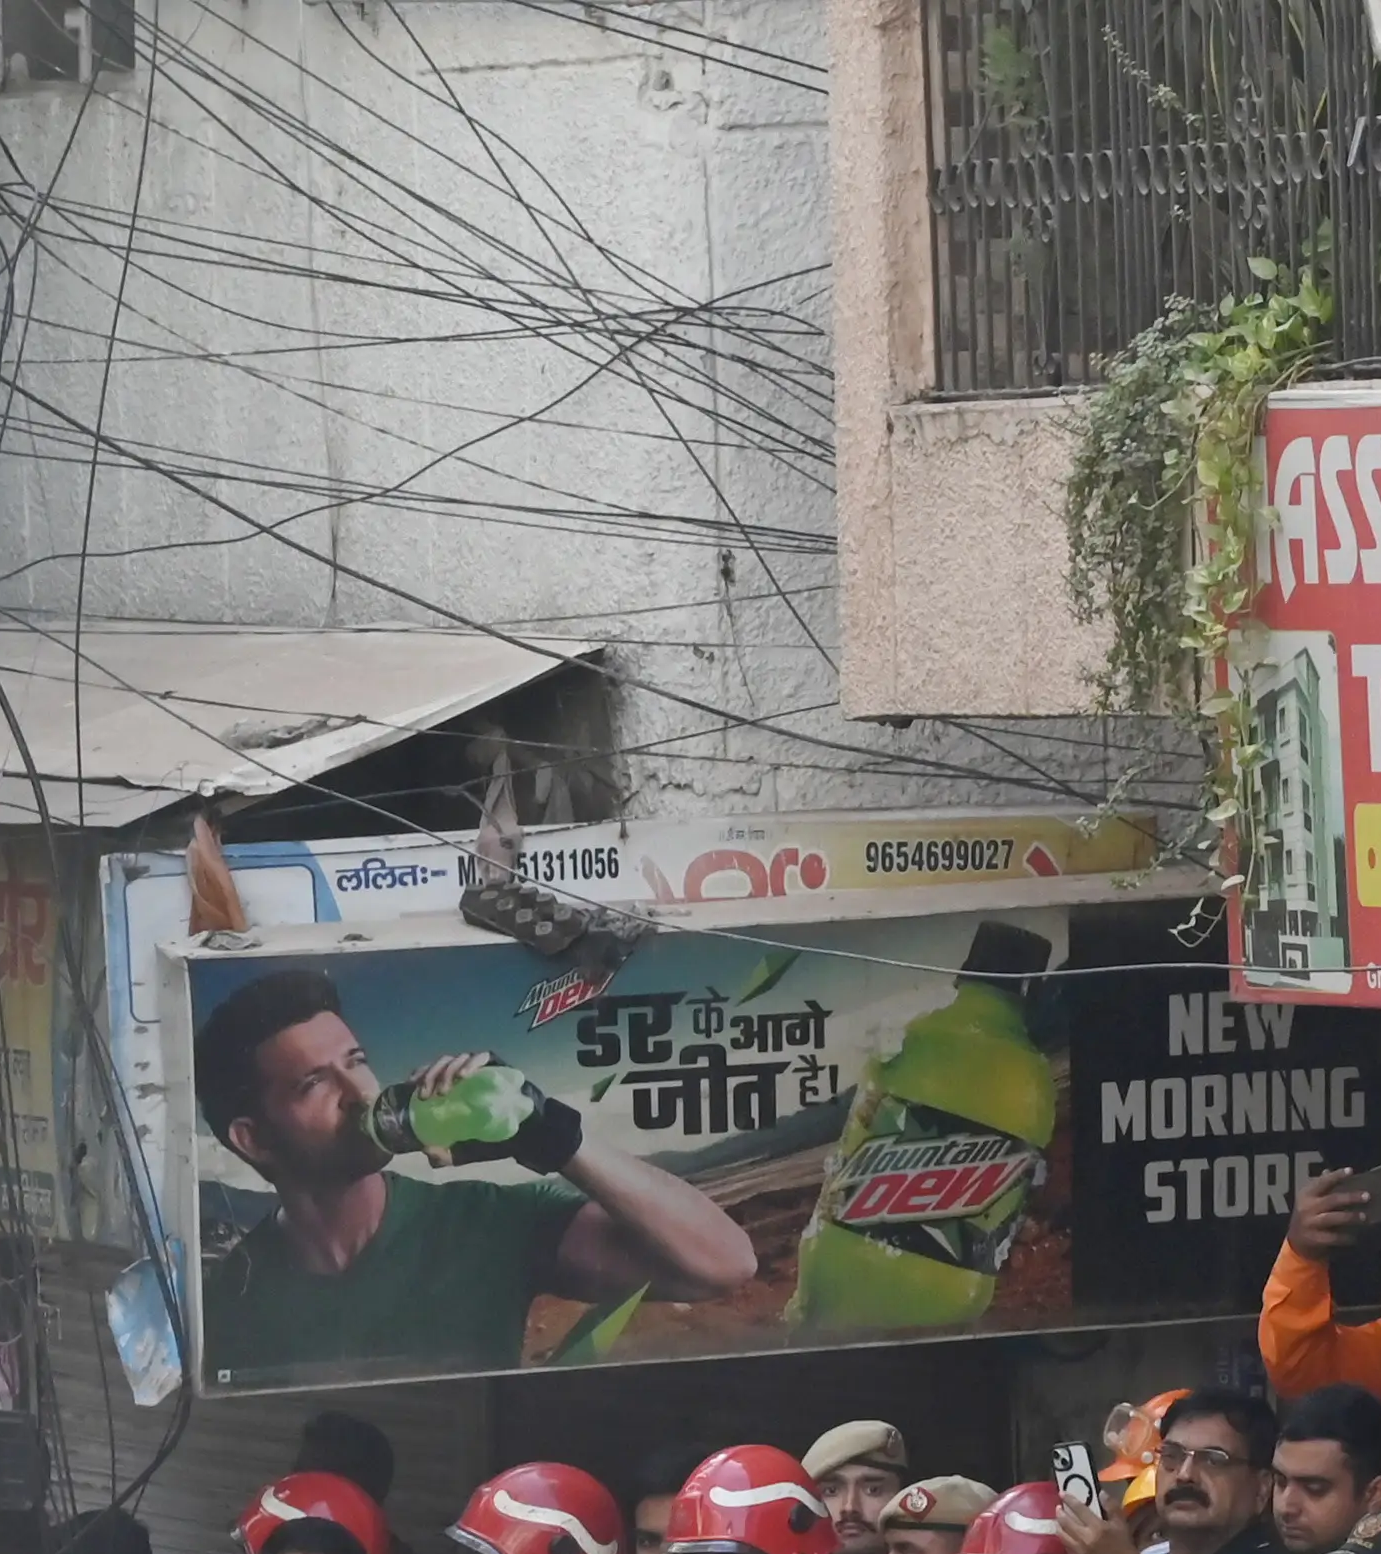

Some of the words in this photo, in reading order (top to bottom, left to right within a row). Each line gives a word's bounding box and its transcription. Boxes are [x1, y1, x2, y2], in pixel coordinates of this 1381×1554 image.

[503, 847, 619, 884] 51311056
[865, 839, 1015, 875] 9654699027
[576, 990, 687, 1068] डर
[686, 986, 730, 1041] के
[730, 1000, 834, 1055] आगे
[1168, 991, 1296, 1057] NEW
[620, 1043, 792, 1137] जीत
[1100, 1066, 1367, 1144] MORNING
[845, 1137, 1010, 1179] Mountain
